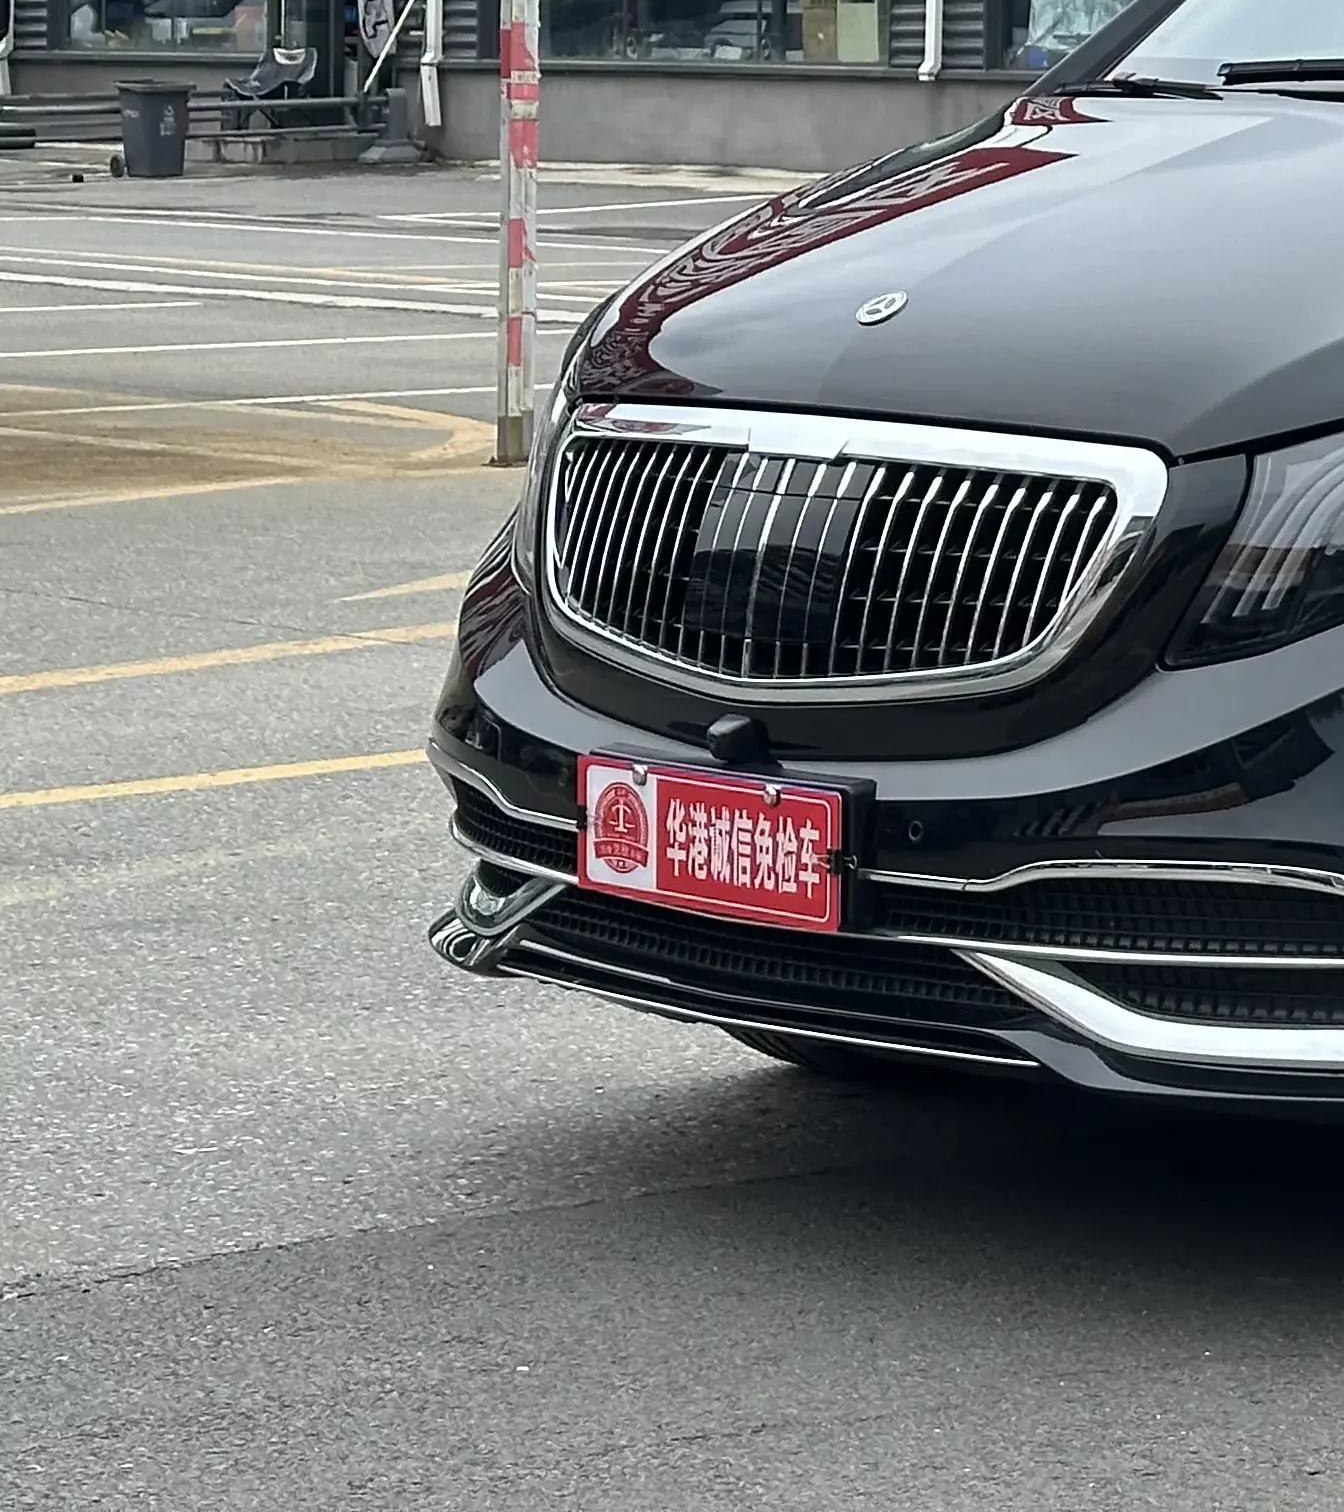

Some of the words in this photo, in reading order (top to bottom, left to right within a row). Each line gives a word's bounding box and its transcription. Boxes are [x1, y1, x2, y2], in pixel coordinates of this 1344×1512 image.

[665, 798, 821, 899] 华港诚信免检车
